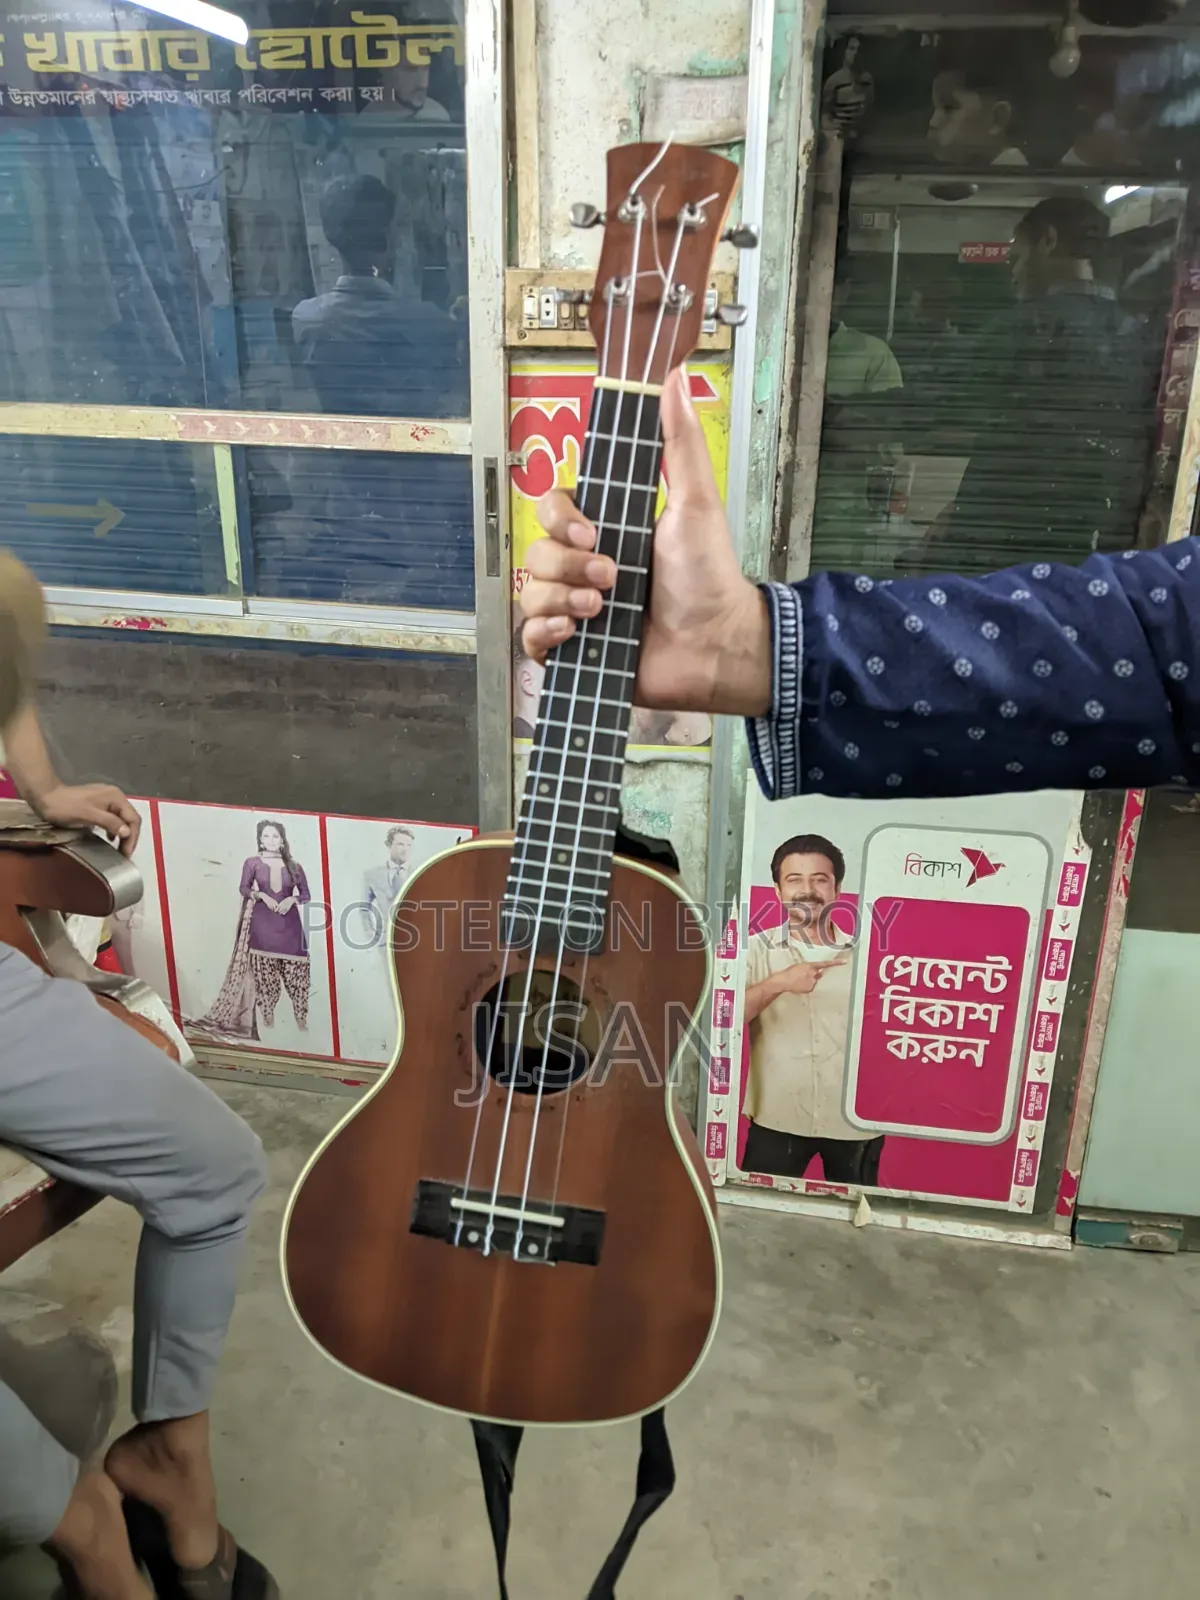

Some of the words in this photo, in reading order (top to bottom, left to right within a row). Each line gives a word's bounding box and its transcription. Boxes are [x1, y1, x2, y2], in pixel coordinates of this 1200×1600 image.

[24, 28, 211, 81] খাবার
[235, 11, 466, 70] হোটেল
[237, 84, 313, 104] পরিবেশন
[319, 86, 353, 102] করা
[904, 852, 962, 878] বিকাশ
[879, 955, 1012, 993] পেমেন্ট
[879, 985, 1004, 1033] বিকাশ
[885, 1030, 990, 1067] করুন
